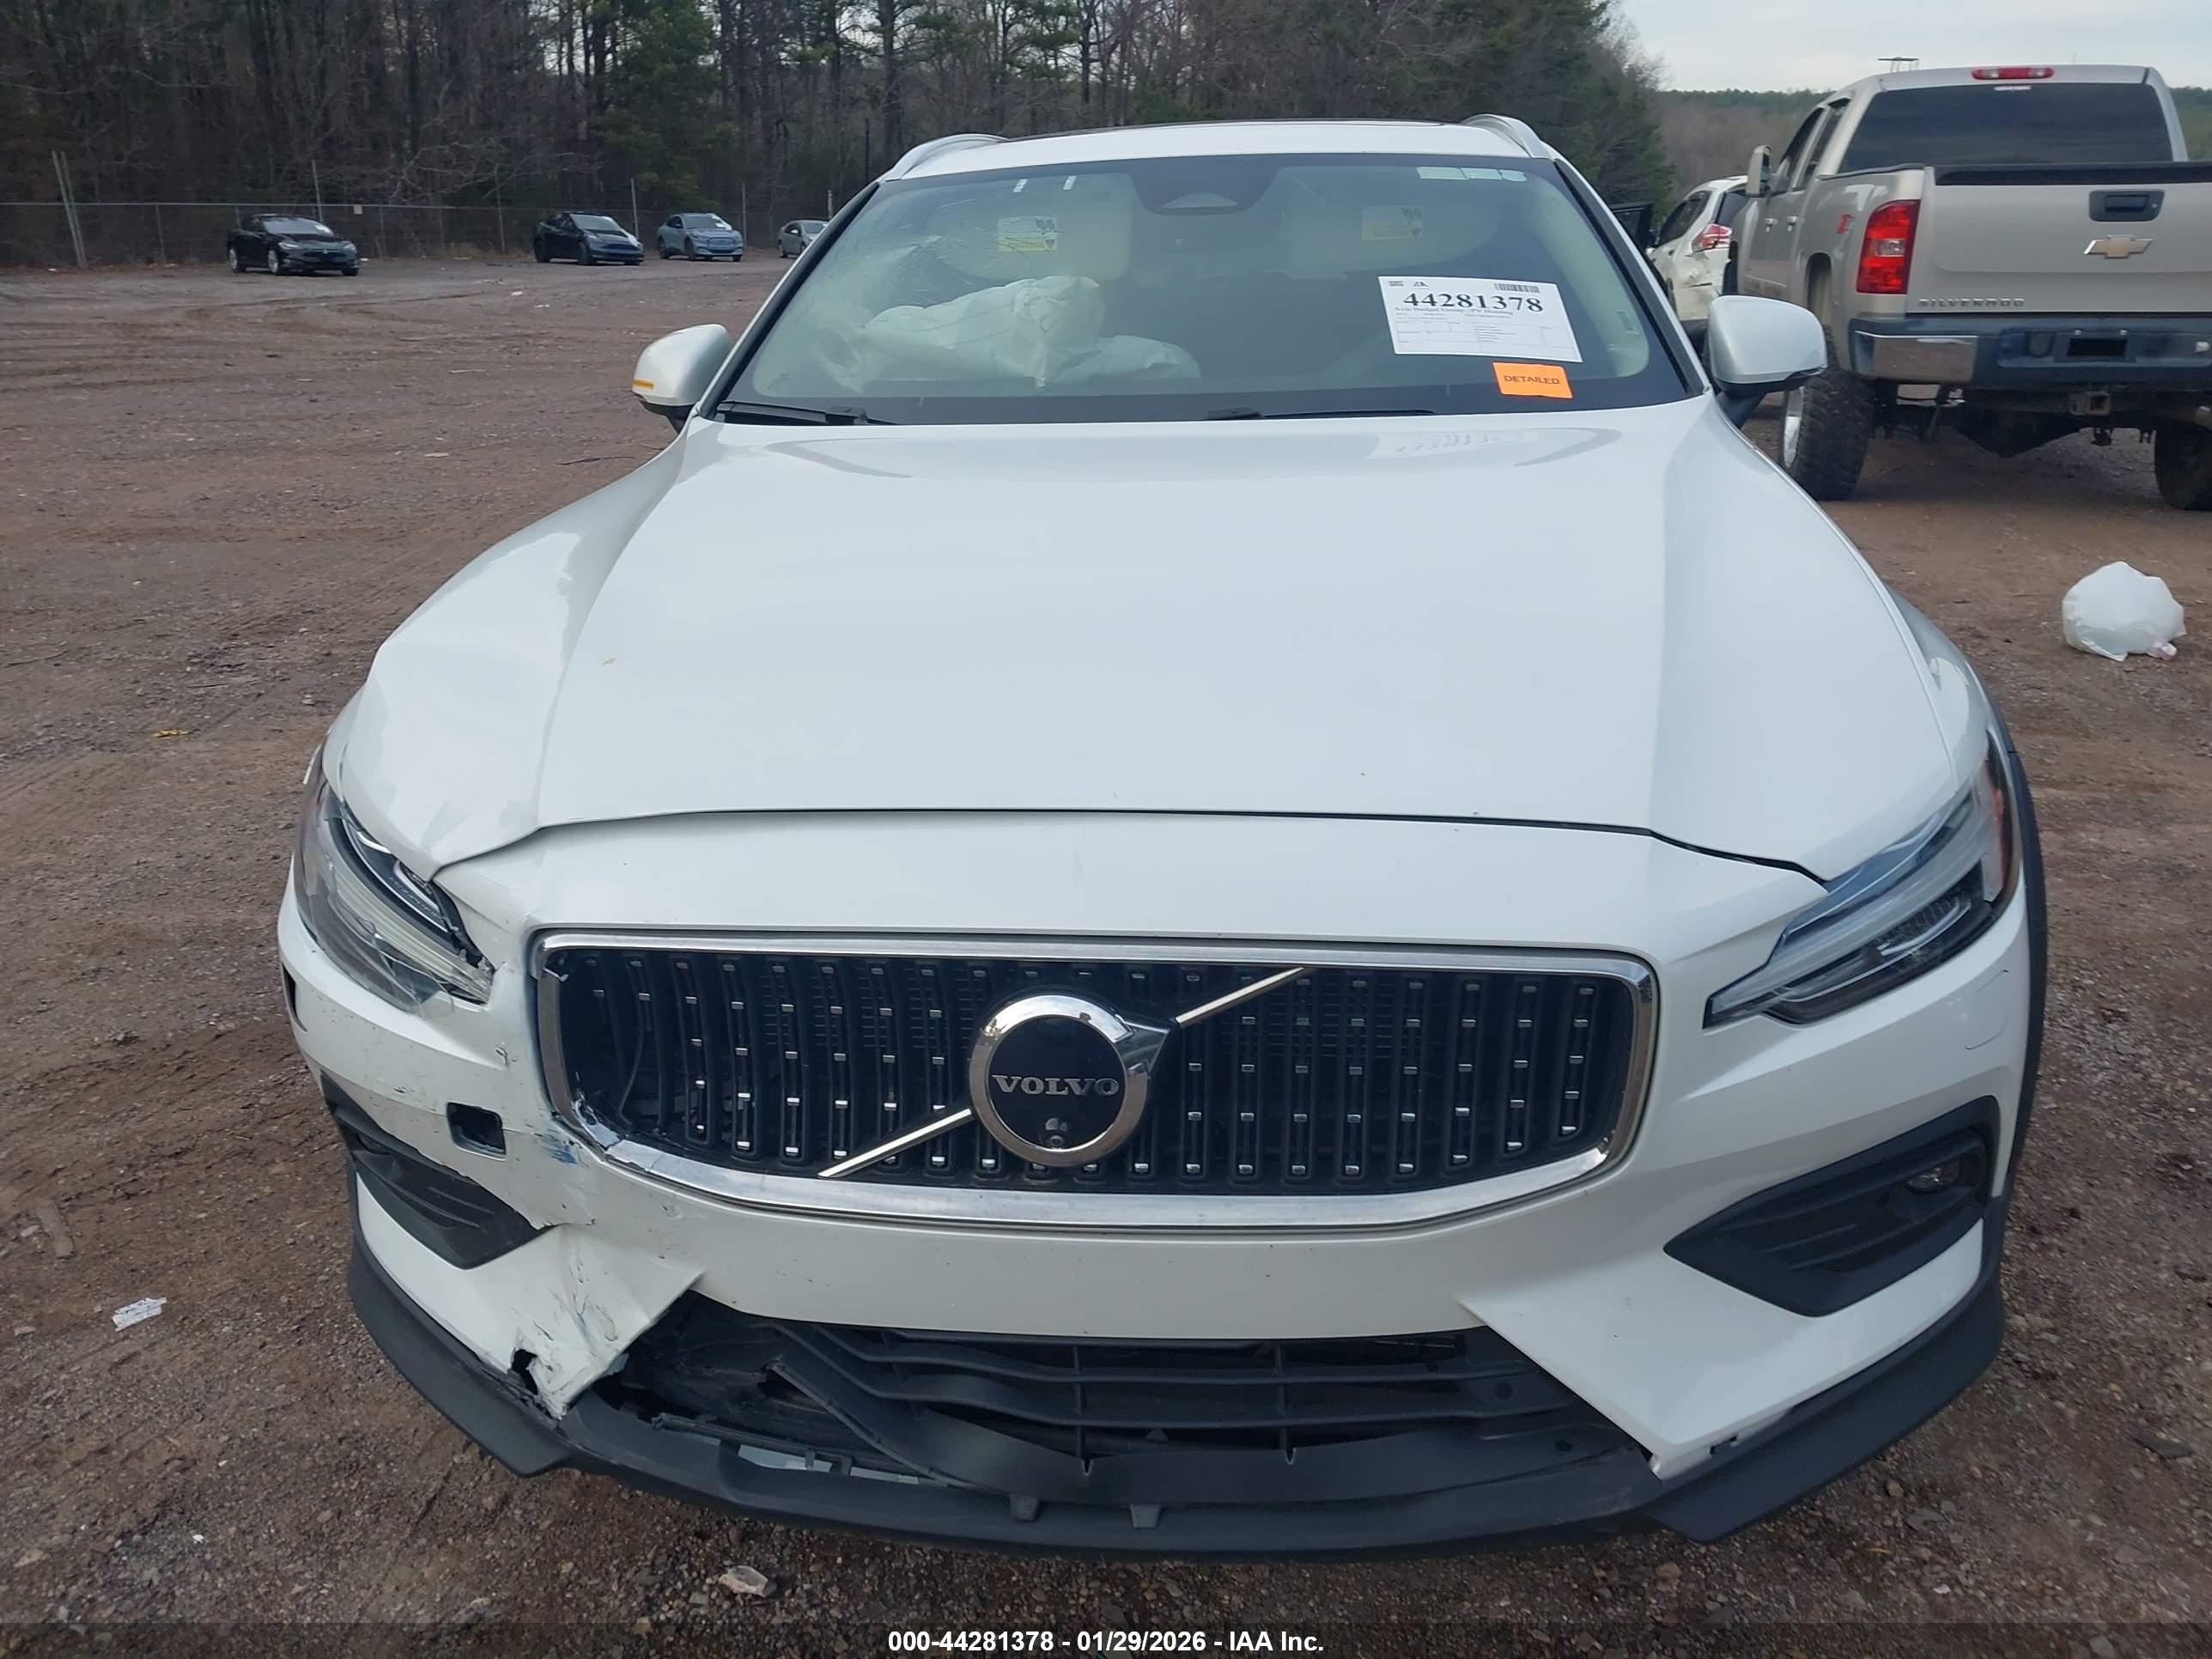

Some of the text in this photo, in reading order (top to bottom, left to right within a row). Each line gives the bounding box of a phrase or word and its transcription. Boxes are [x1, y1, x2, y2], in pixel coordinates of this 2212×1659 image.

[1403, 293, 1543, 312] 44281378
[1917, 298, 2025, 307] SILVERADO
[1504, 375, 1559, 385] DETAILED
[992, 1074, 1119, 1096] VOLVO
